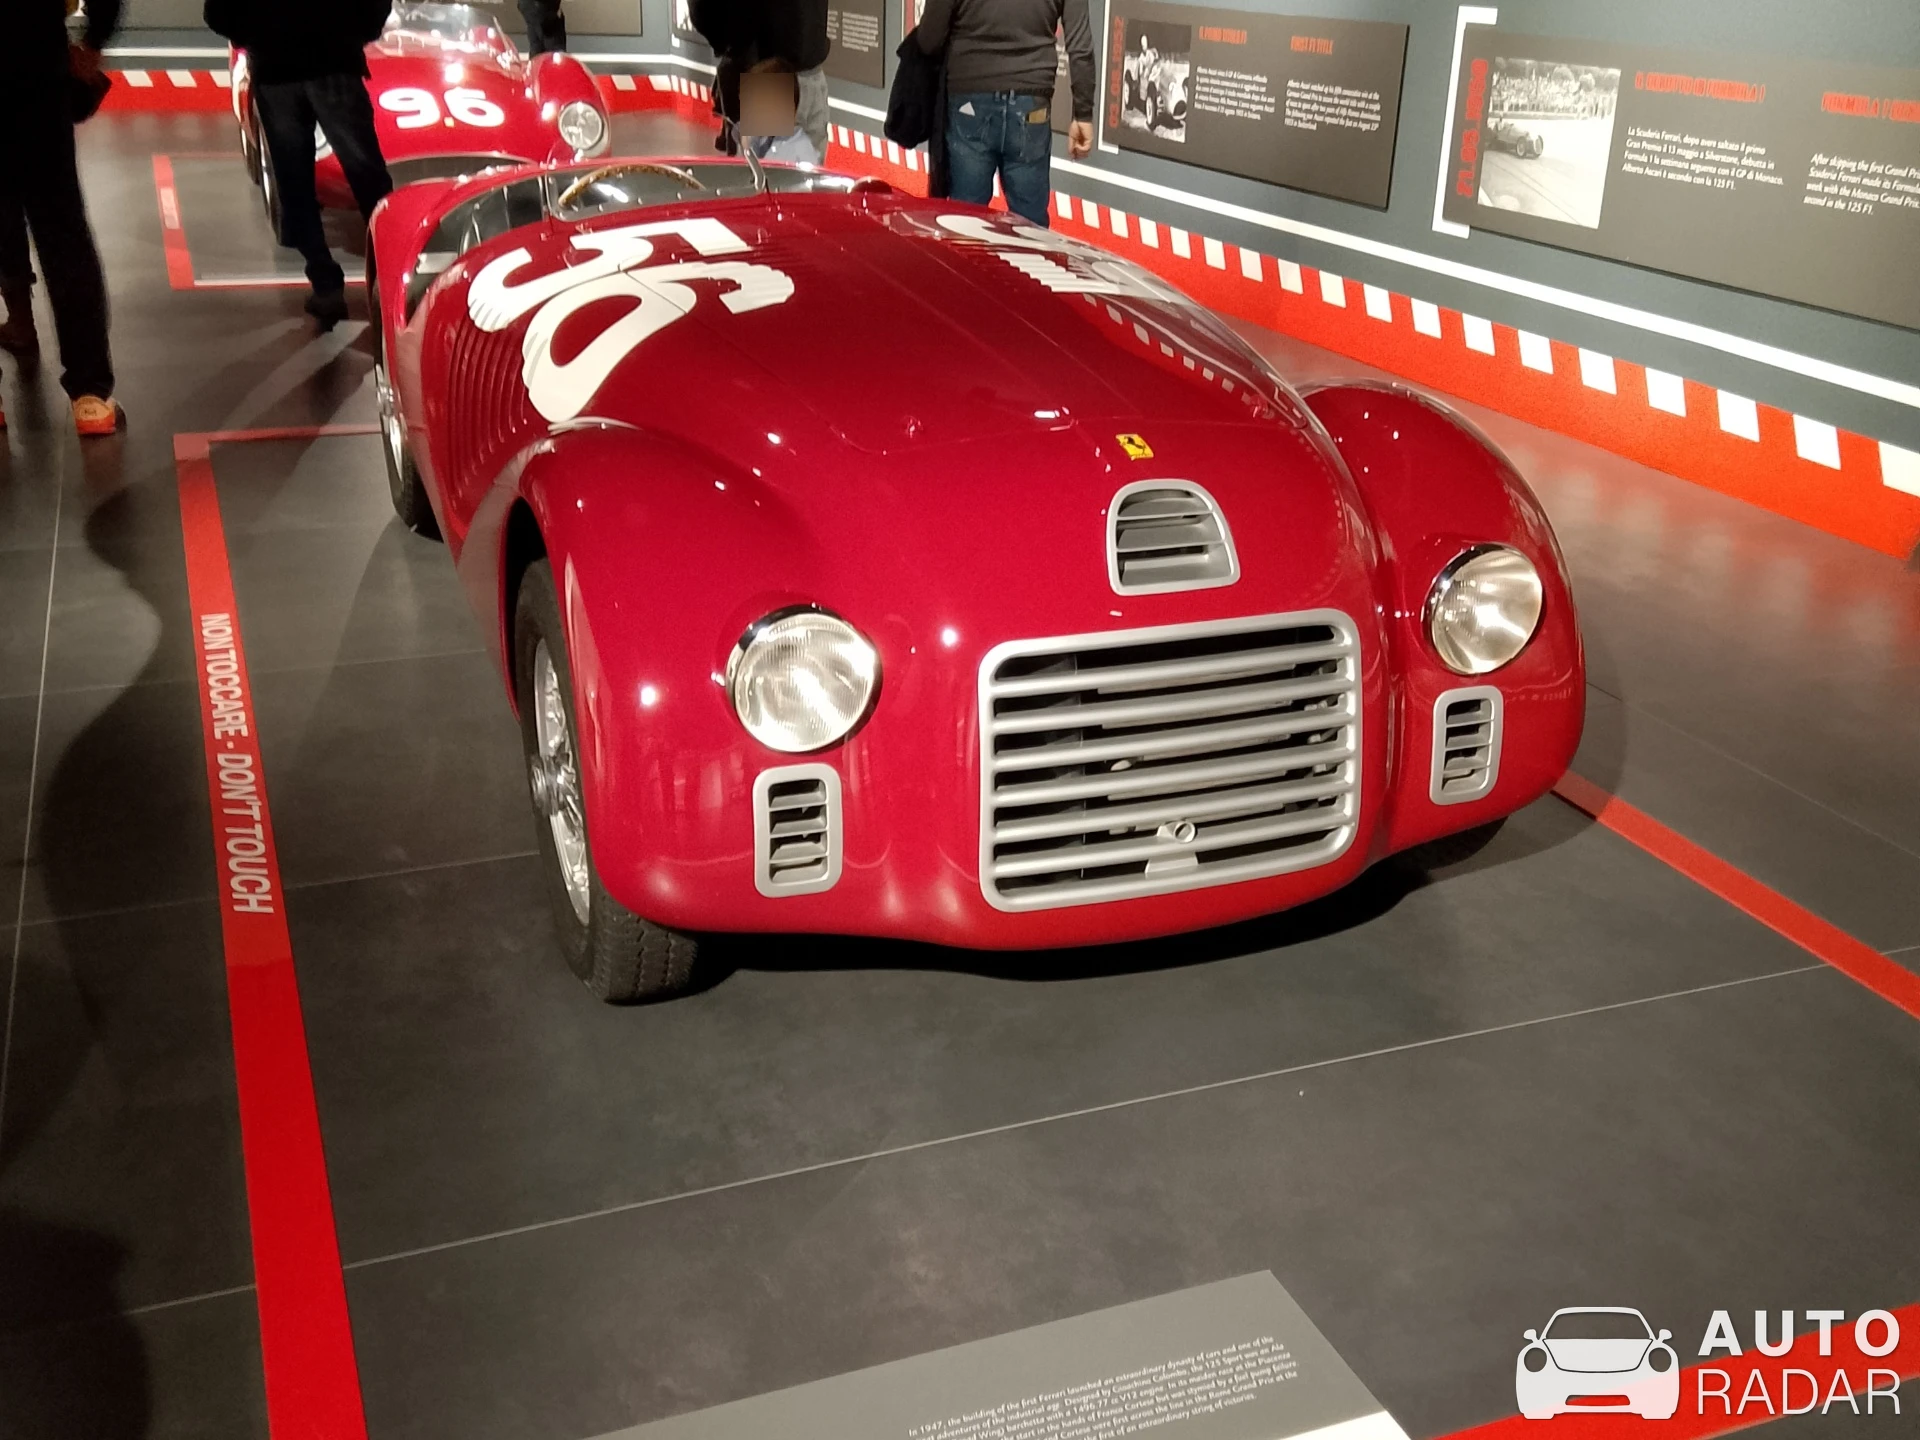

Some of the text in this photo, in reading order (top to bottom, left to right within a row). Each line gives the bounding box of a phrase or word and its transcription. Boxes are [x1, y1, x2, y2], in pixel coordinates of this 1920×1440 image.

[200, 613, 275, 914] NON TOCCARE DON'T TOUCH
[908, 1429, 918, 1437] In
[948, 1418, 961, 1427] the
[962, 1408, 997, 1422] building
[997, 1404, 1005, 1414] of
[1006, 1402, 1019, 1411] the
[1021, 1397, 1037, 1408] first
[1038, 1389, 1066, 1402] Ferrari
[1067, 1379, 1102, 1394] launched
[1115, 1363, 1166, 1382] extraordinary
[1167, 1356, 1195, 1370] dynasty
[1196, 1352, 1204, 1362] of
[1205, 1350, 1221, 1359] cars
[1222, 1344, 1237, 1355] and
[1237, 1342, 1251, 1350] one
[1252, 1337, 1261, 1347] of
[1261, 1335, 1274, 1345] the
